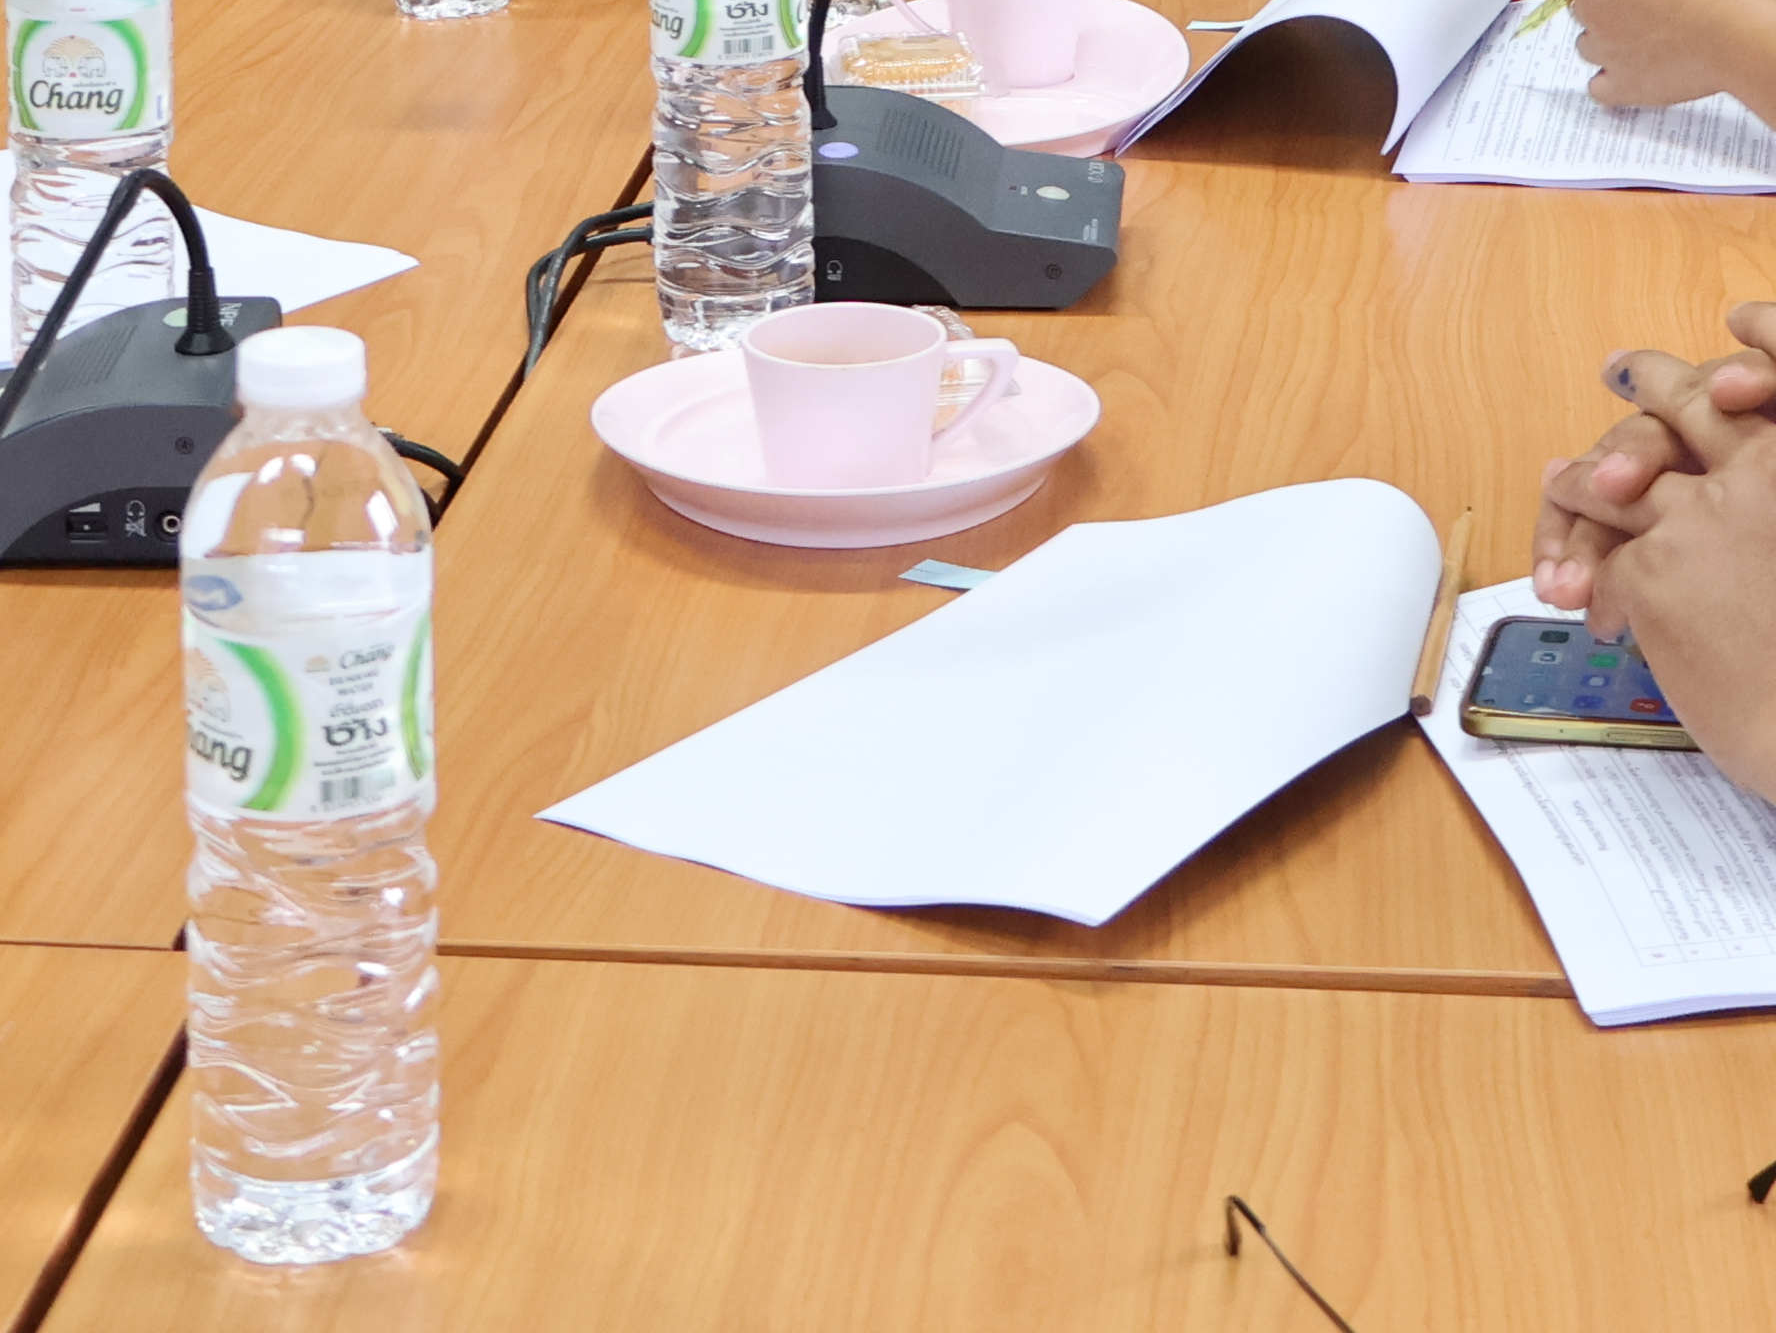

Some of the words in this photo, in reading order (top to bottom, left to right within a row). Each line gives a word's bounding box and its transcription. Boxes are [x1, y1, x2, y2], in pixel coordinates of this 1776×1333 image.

[651, 8, 684, 40] ang
[28, 78, 126, 115] Chang
[189, 728, 253, 783] ang
